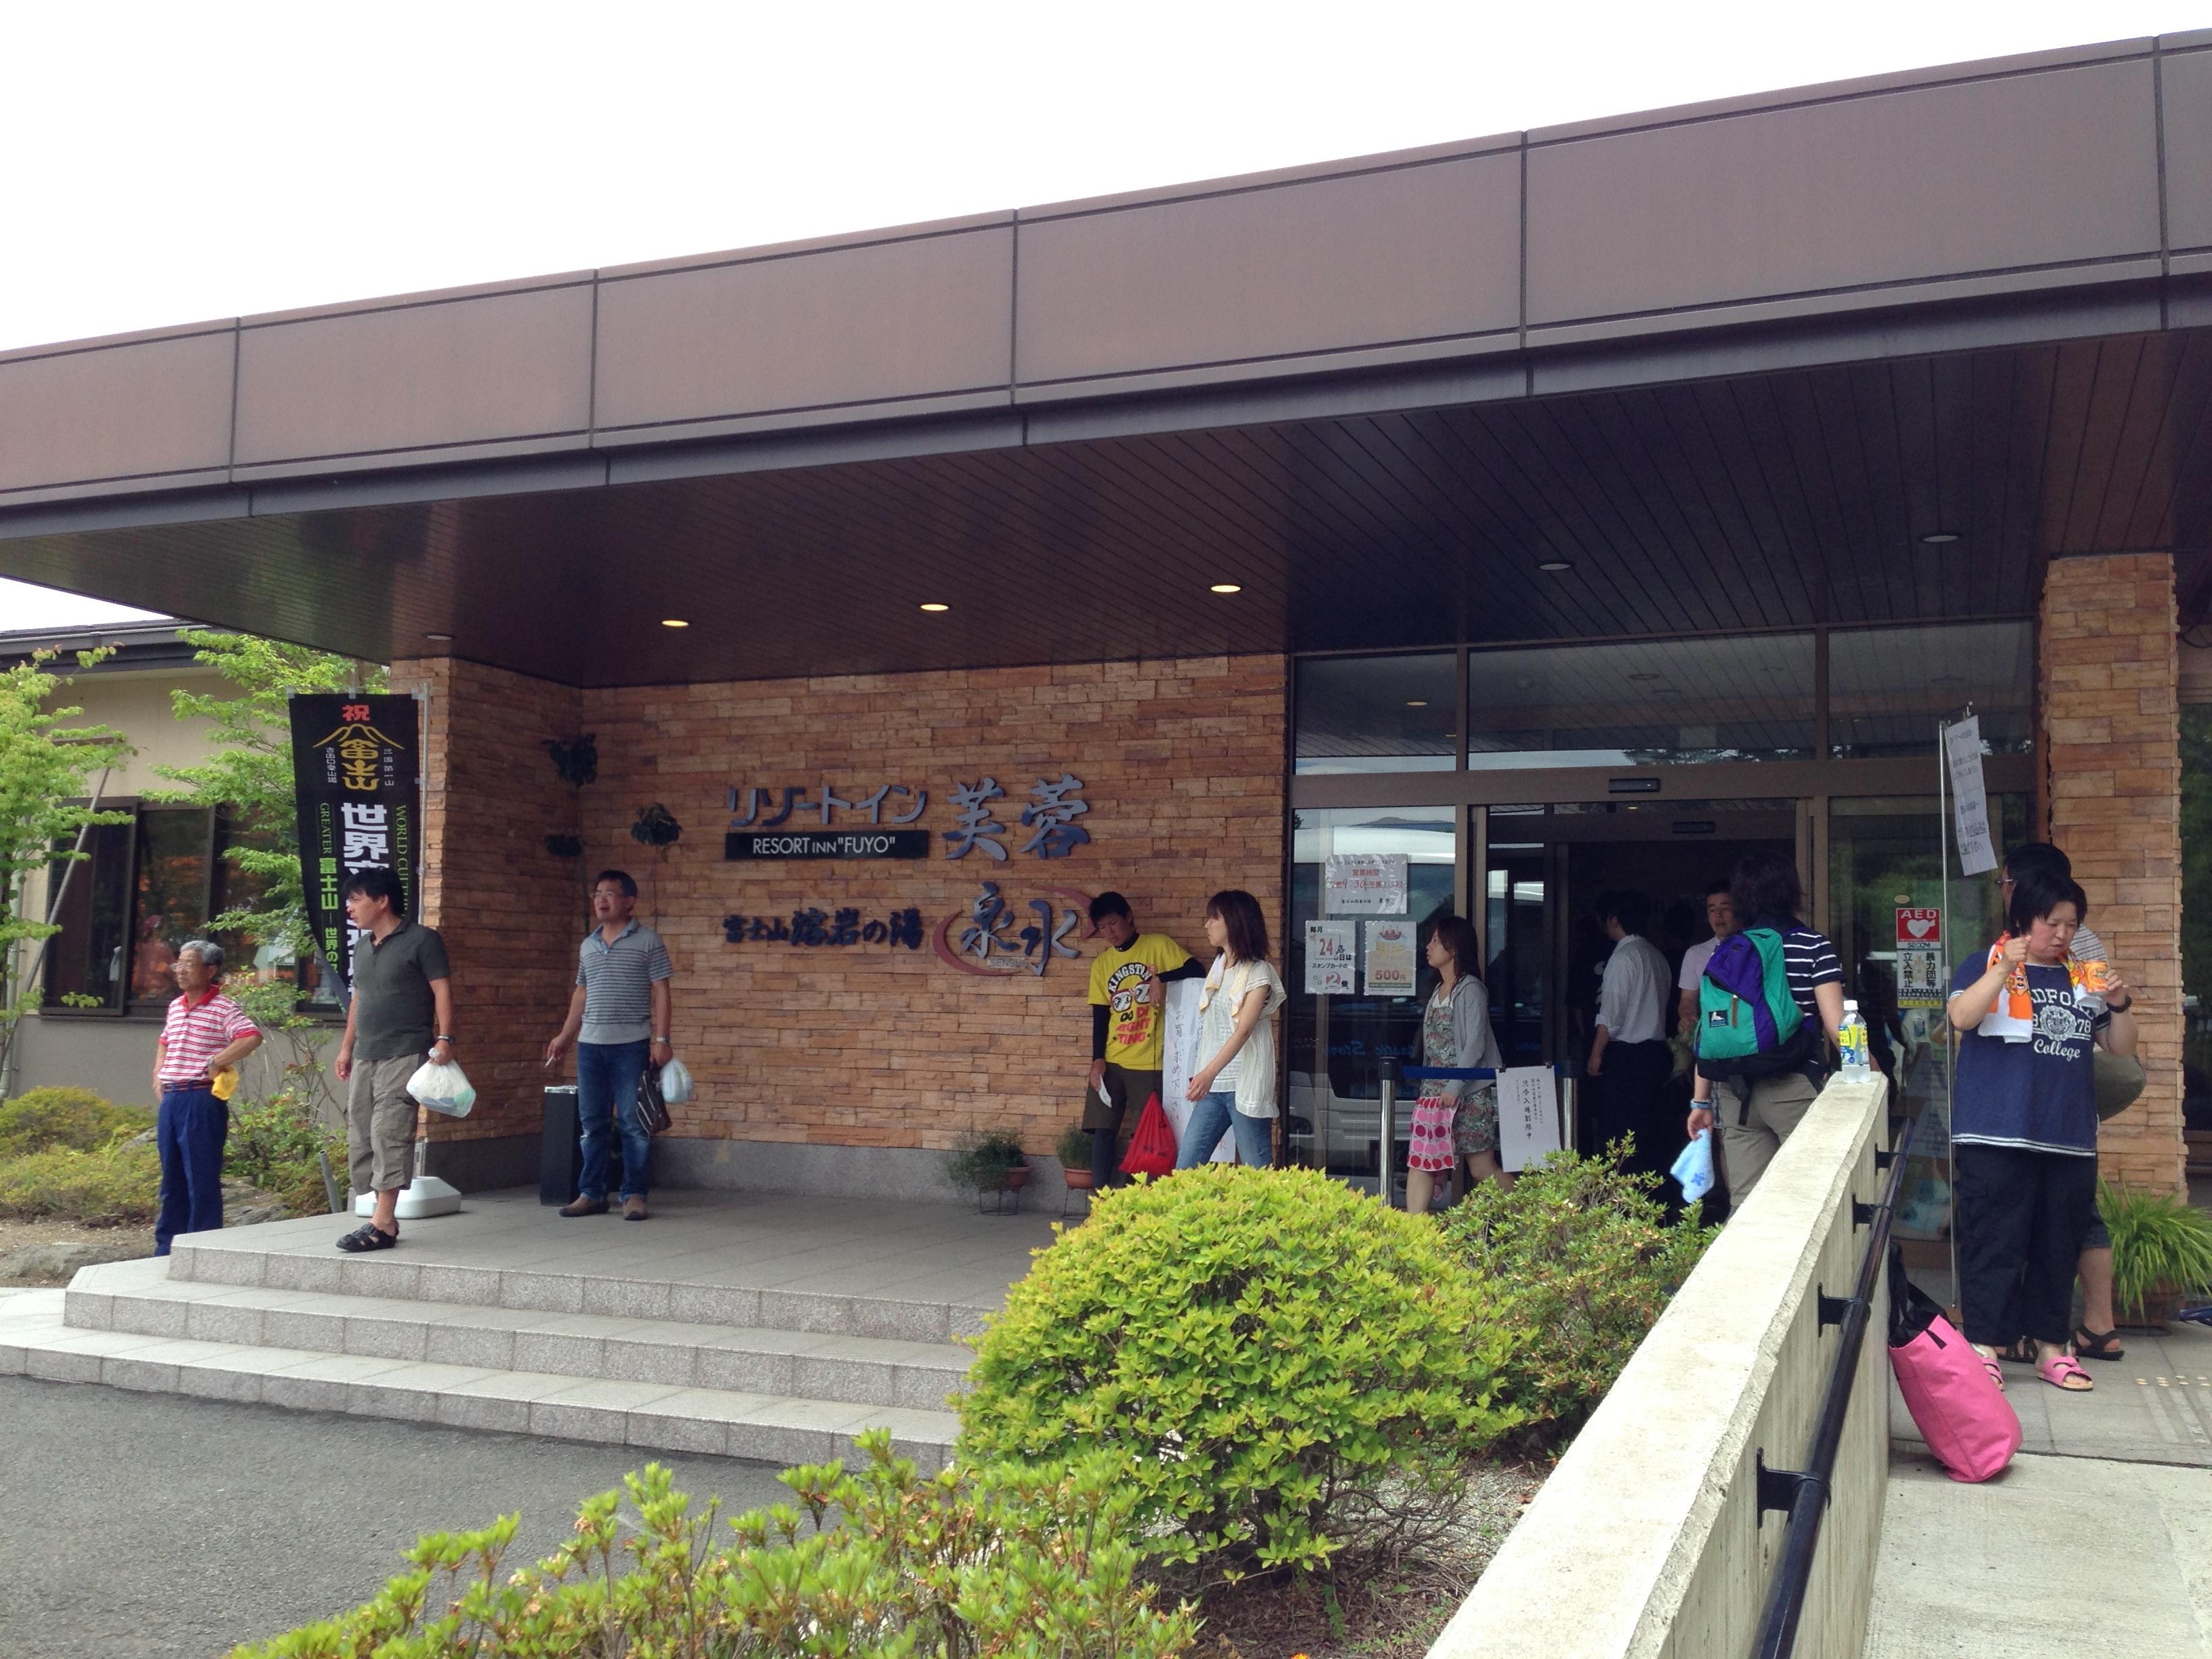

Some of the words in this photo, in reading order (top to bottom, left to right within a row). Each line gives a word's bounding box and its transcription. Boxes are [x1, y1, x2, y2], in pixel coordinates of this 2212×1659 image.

[342, 704, 370, 721] 祝
[320, 802, 332, 854] GREATER
[729, 785, 926, 828] リゾートイン
[943, 773, 1090, 861] 芙蓉
[396, 805, 407, 855] WORLD
[753, 838, 811, 855] RESORT
[813, 842, 836, 854] INN
[838, 836, 896, 854] "FUYO"
[319, 858, 338, 909] 富士山
[1900, 909, 1937, 919] AED
[723, 907, 924, 950] 富士山溶岩の湯
[961, 881, 1082, 977] 泉水
[1319, 937, 1334, 956] 24
[1375, 970, 1406, 981] 500円
[1903, 951, 1913, 988] 立入禁止
[2077, 1019, 2091, 1033] 78
[2034, 1039, 2081, 1062] College
